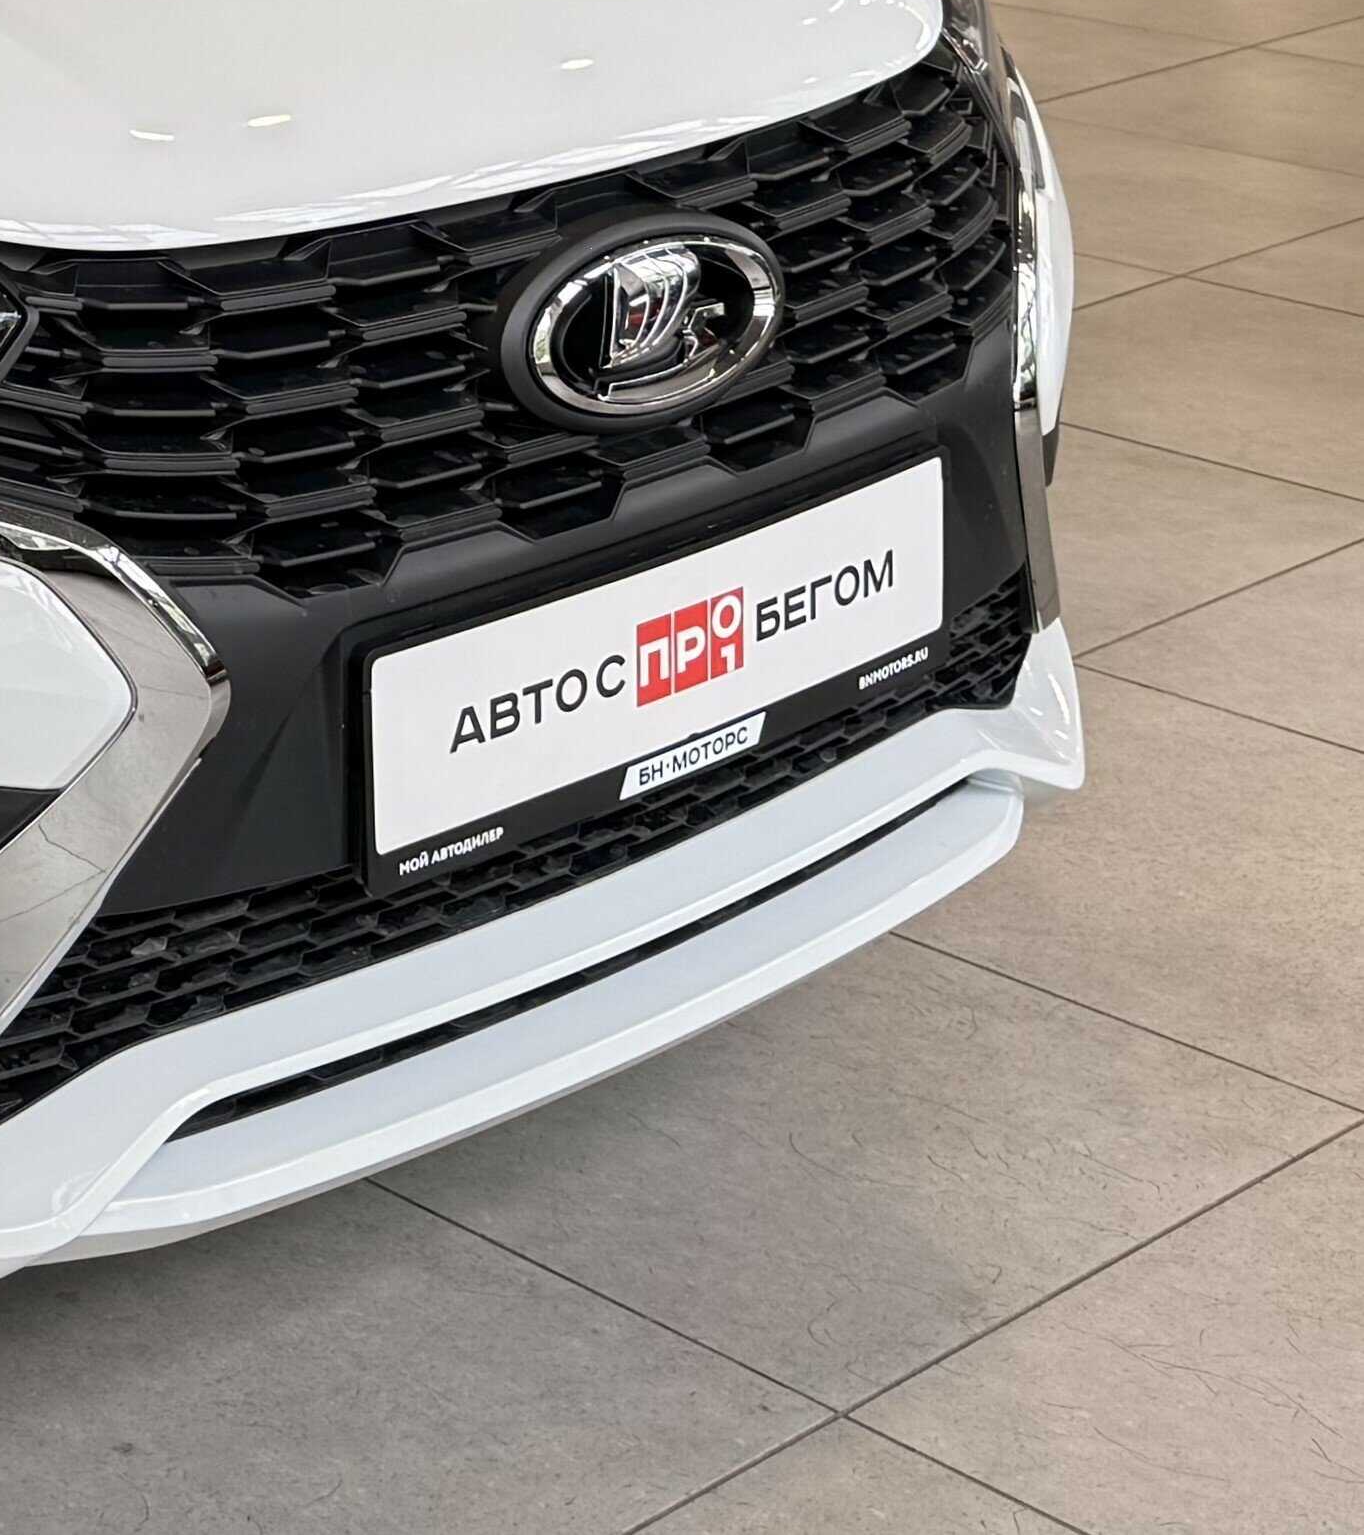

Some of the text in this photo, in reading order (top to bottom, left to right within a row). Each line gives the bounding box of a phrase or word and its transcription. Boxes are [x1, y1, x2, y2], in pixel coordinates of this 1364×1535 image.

[858, 645, 929, 691] BNMOTORS.RU
[449, 667, 588, 754] АВТО
[595, 654, 626, 697] С
[398, 825, 505, 876] МОЙ АВТОДИЛЕР
